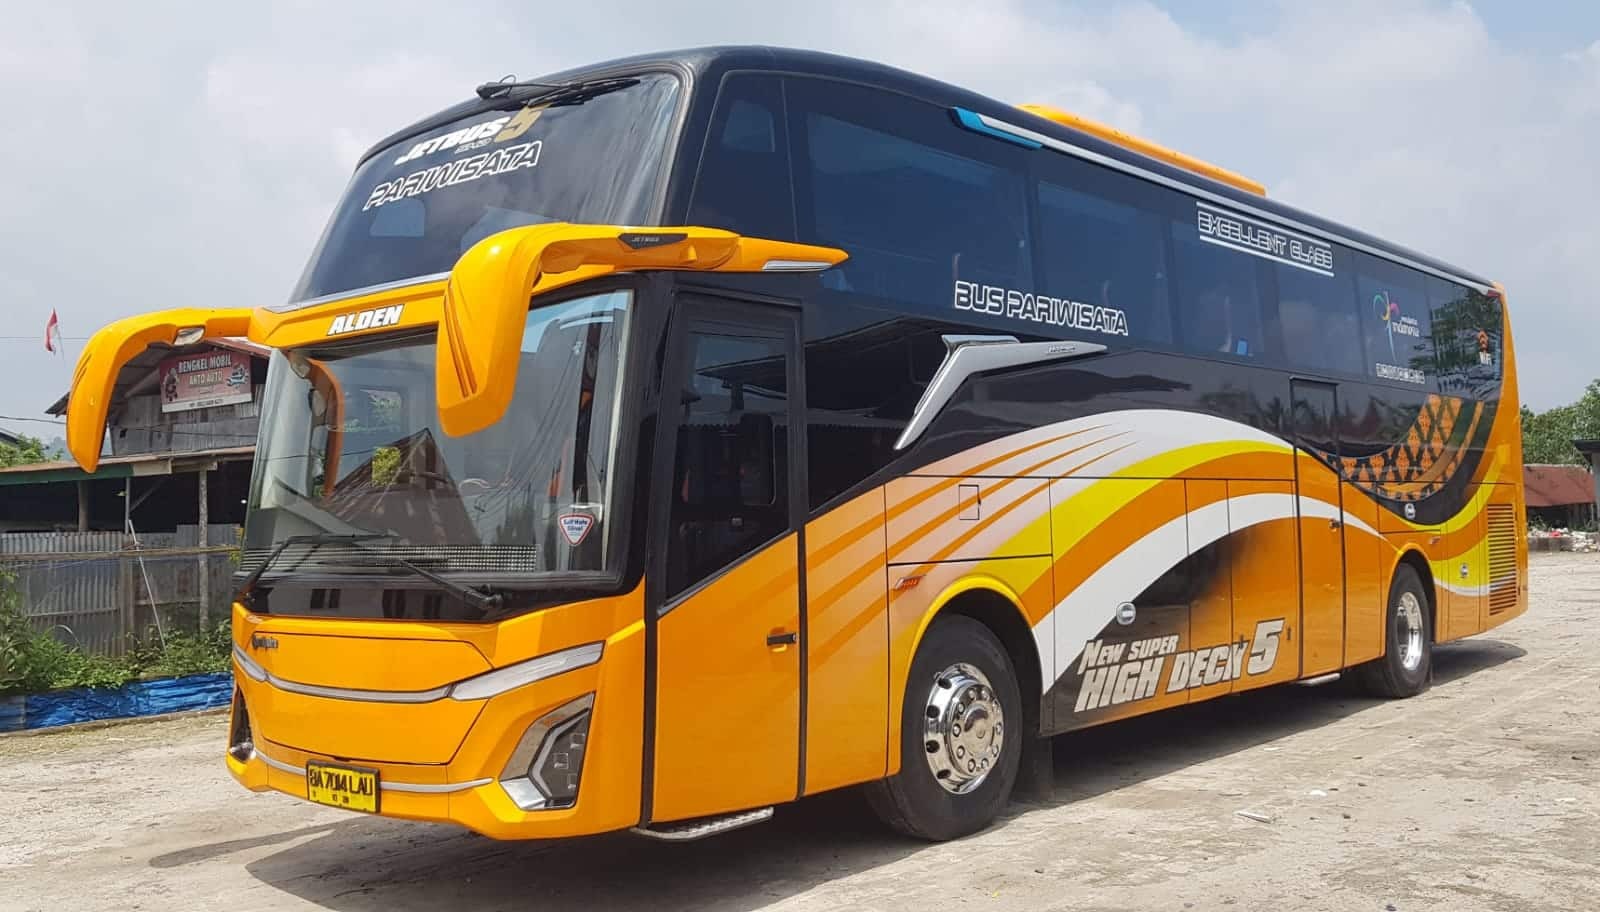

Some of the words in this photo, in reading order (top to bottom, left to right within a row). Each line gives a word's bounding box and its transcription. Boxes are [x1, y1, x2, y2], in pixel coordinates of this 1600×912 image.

[394, 116, 511, 165] JETBUS
[362, 140, 543, 212] PARIWISATA
[1198, 210, 1287, 256] EXCELLENT
[1289, 239, 1333, 270] CLASS
[326, 303, 405, 336] ALDEN
[954, 280, 1004, 315] BUS
[1007, 290, 1129, 337] PARIWISATA
[178, 359, 208, 373] BENGKEL
[1073, 656, 1165, 713] HIGH
[1166, 641, 1250, 694] DECK
[1247, 617, 1287, 676] 5
[1129, 634, 1180, 661] SUPER
